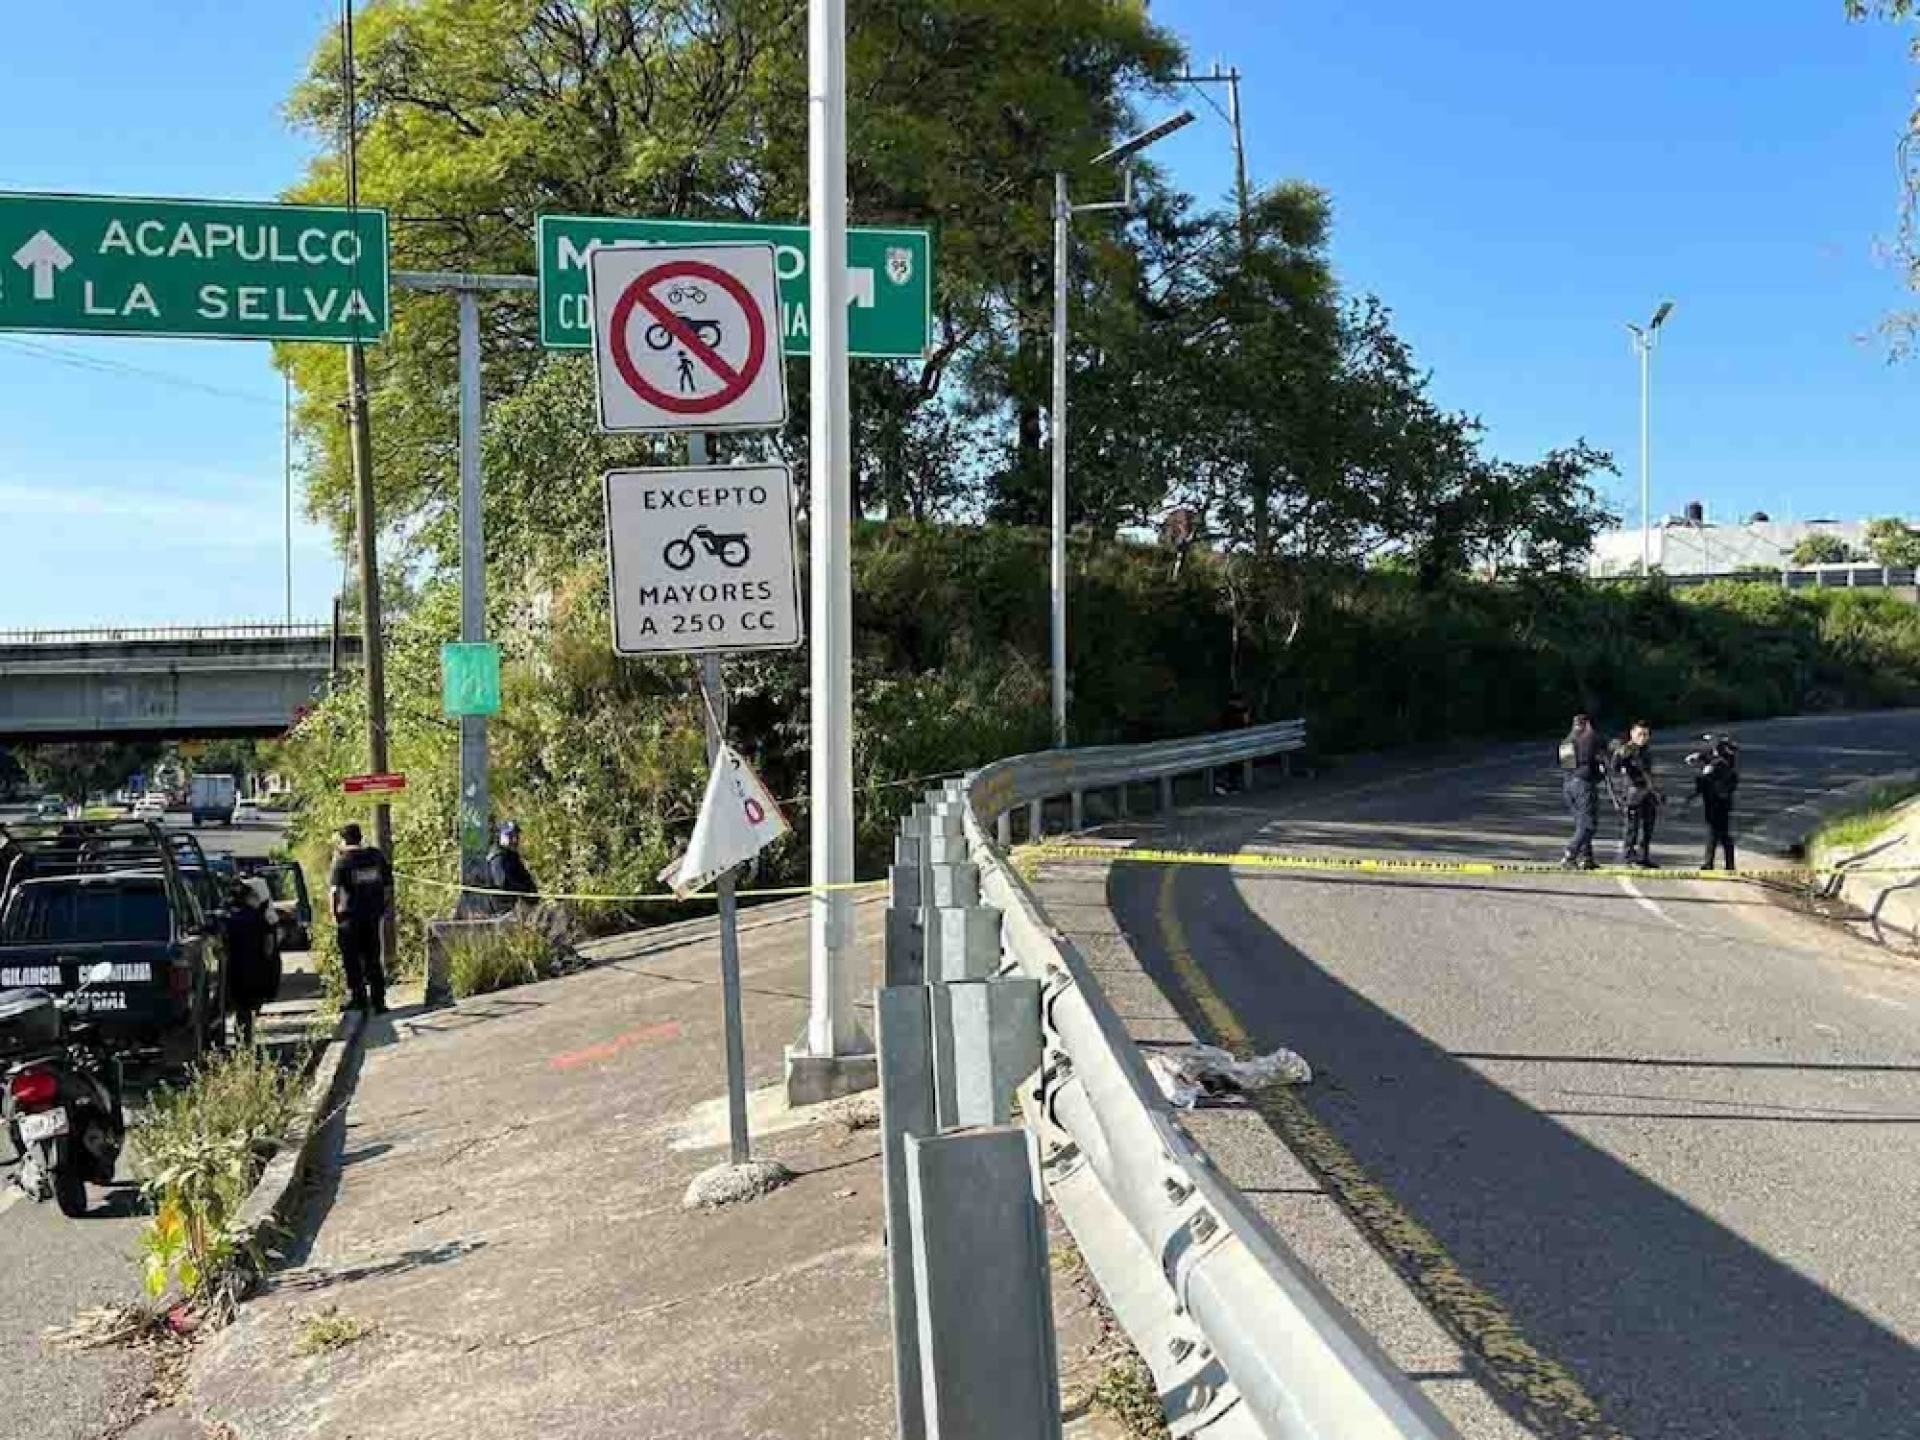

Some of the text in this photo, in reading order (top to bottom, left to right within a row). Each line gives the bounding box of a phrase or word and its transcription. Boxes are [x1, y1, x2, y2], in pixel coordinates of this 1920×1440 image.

[99, 219, 362, 265] ACAPULCO
[84, 280, 376, 324] LA SELVA
[643, 485, 768, 511] EXCEPTO
[639, 580, 773, 607] MAYORES
[640, 610, 776, 635] A 250 CC
